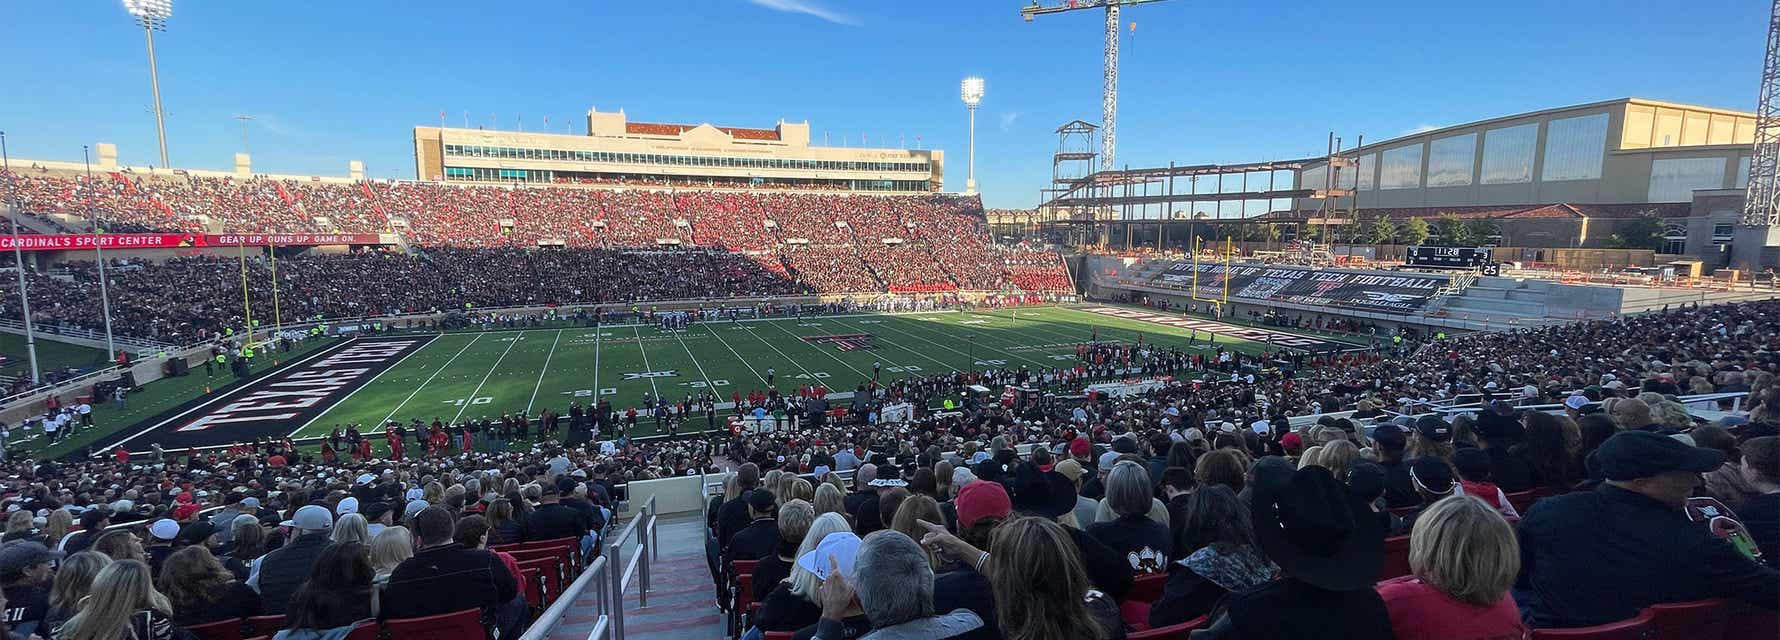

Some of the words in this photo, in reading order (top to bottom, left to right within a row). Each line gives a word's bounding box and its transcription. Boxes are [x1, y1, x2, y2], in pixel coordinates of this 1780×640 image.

[1, 237, 70, 248] CARDINAL'S
[76, 236, 114, 246] SPORT
[118, 236, 162, 245] CENTER
[219, 235, 246, 244] GEAR
[267, 235, 293, 244] GUNS
[314, 235, 338, 243] GAME
[1483, 265, 1497, 275] 25
[1262, 269, 1307, 280] TEXAS
[1309, 271, 1350, 282] TECH
[1349, 274, 1437, 289] FOOTBALL
[176, 367, 371, 432] TEXAS
[310, 340, 417, 368] TECH
